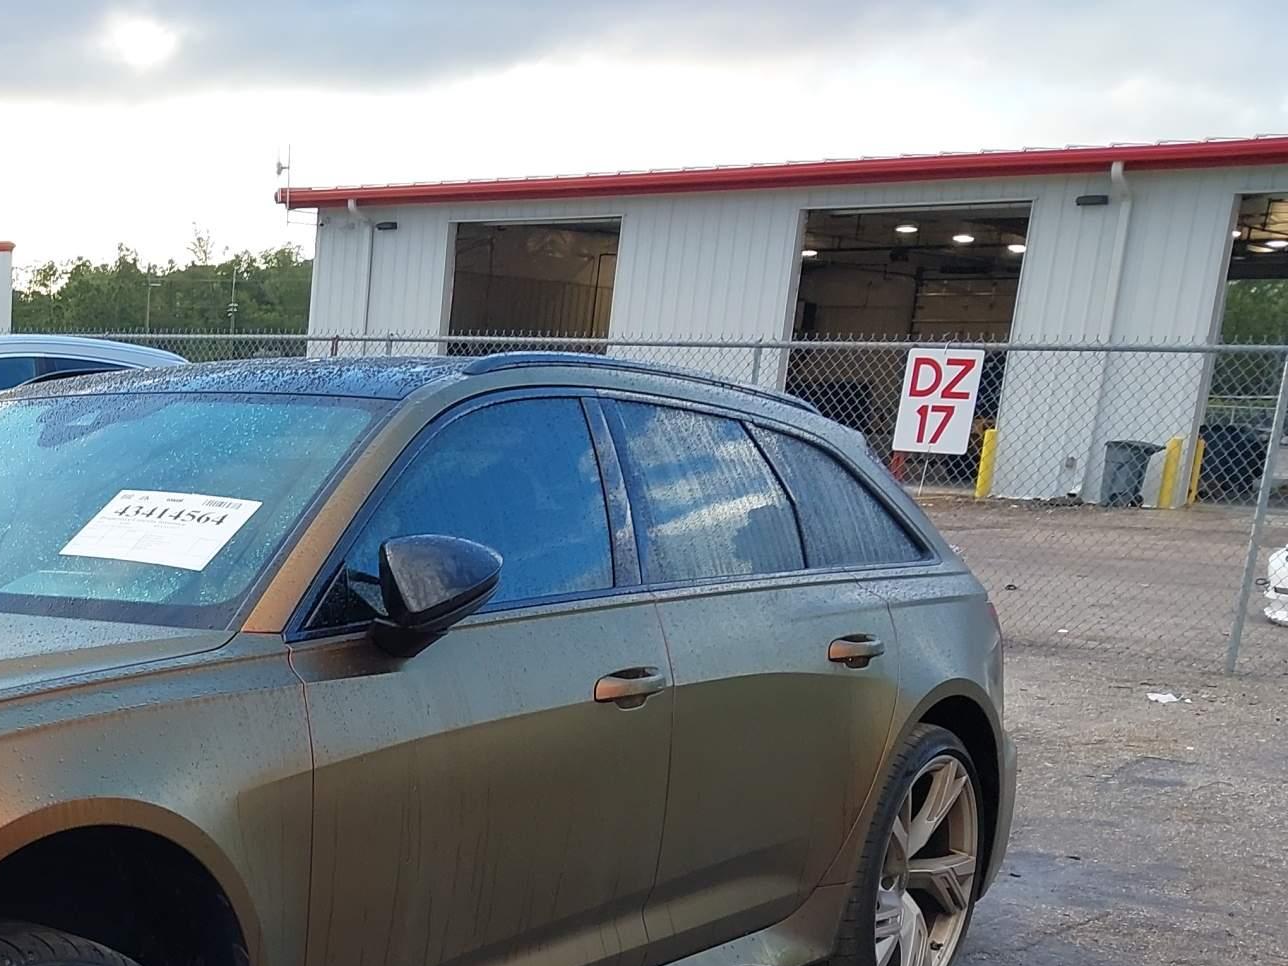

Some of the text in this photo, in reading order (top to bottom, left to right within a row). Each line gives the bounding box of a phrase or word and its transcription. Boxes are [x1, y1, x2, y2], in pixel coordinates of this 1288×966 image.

[909, 357, 976, 399] DZ
[916, 404, 955, 444] 17
[114, 504, 229, 526] 43414564
